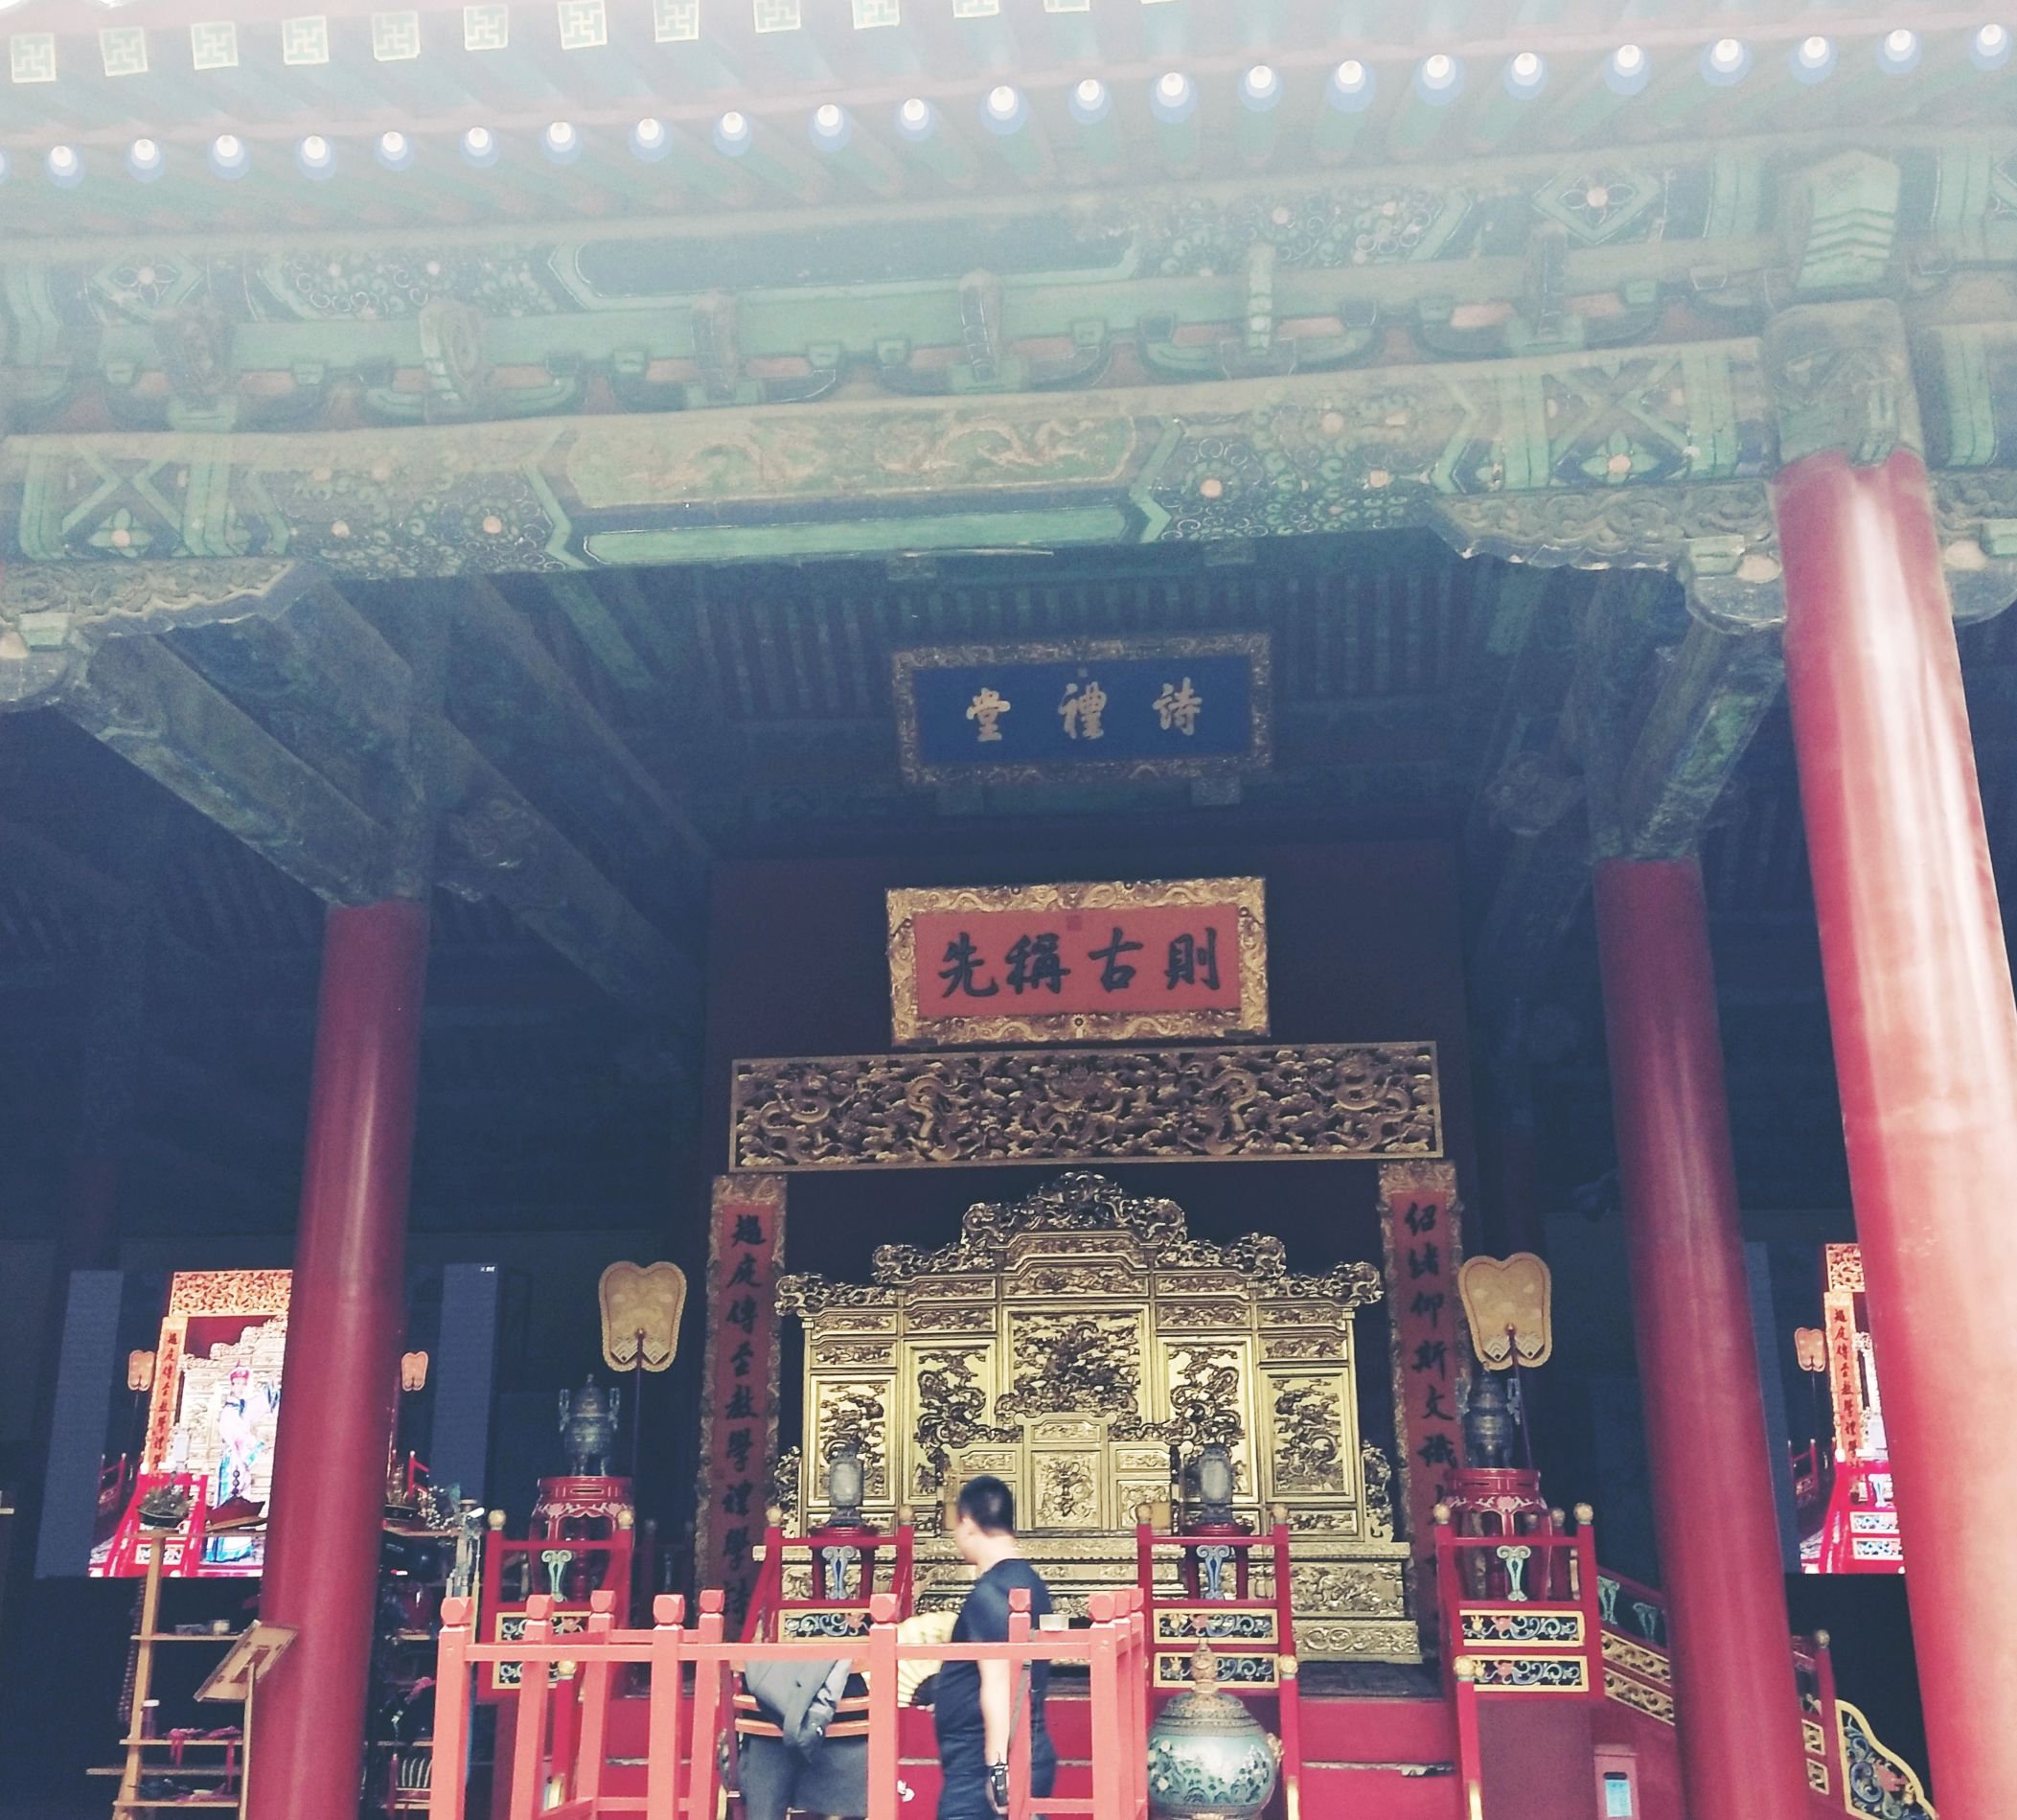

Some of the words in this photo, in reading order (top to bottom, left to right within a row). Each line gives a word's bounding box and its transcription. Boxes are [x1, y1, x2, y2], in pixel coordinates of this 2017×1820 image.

[965, 677, 1203, 743] 詩禮堂
[938, 927, 1223, 998] 則古稱先
